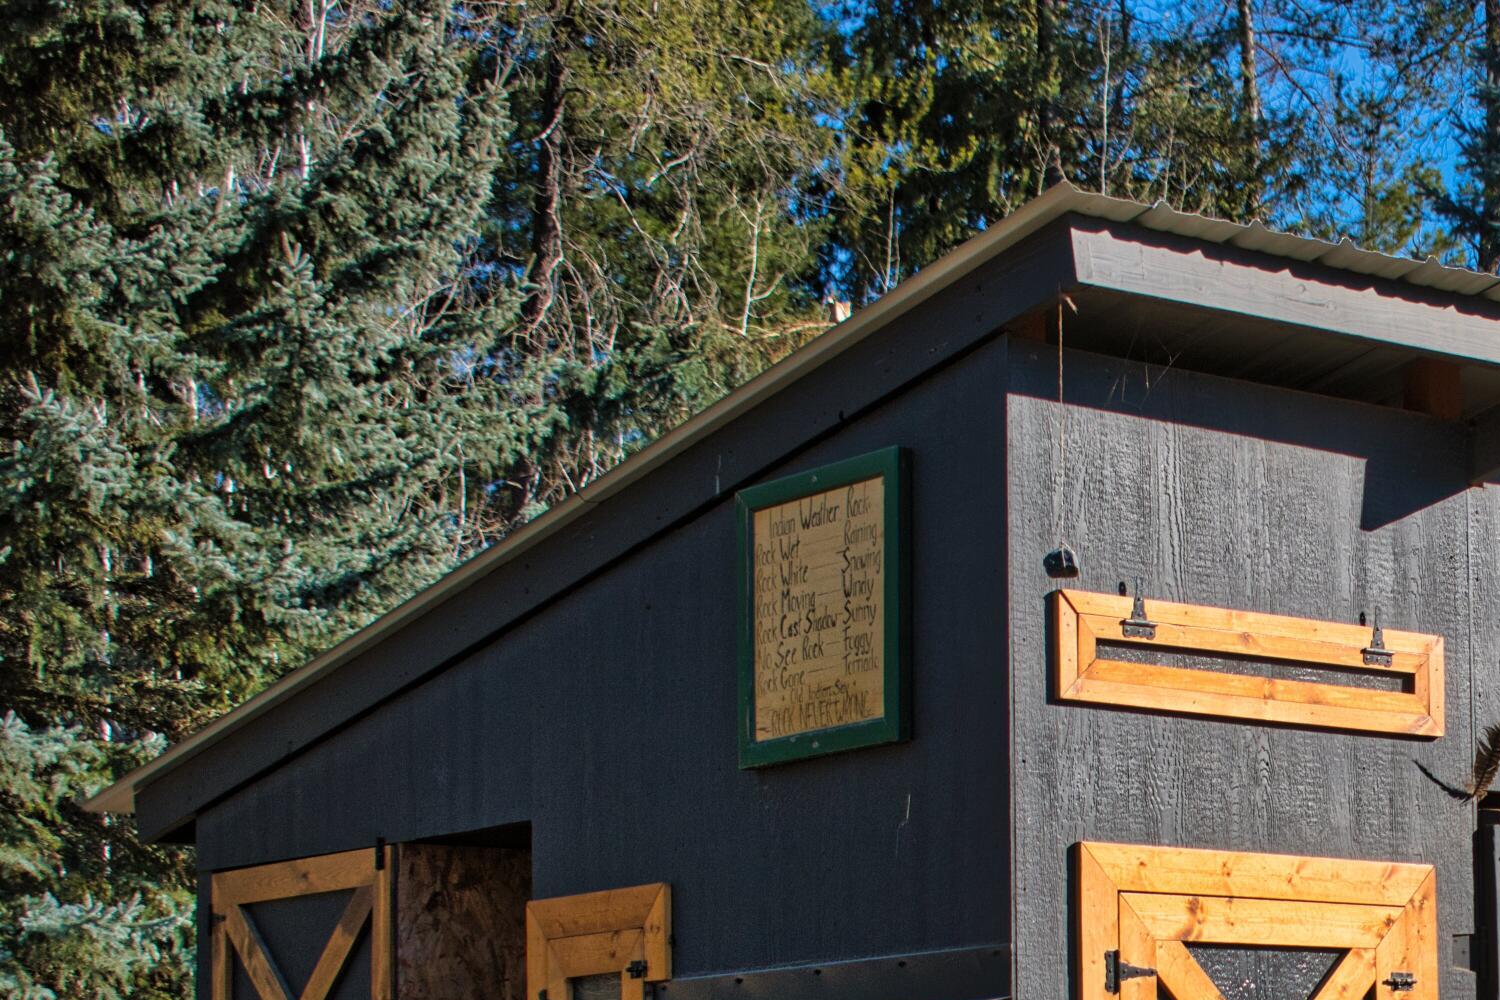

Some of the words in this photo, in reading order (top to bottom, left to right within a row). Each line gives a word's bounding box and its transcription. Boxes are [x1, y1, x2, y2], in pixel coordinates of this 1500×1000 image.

[769, 506, 796, 539] Indian
[800, 495, 840, 531] Weather
[847, 483, 871, 519] Rock
[757, 541, 776, 566] Rock
[780, 535, 800, 561] Wet
[844, 519, 877, 546] Raining
[757, 566, 777, 593] Rock
[780, 561, 808, 587] White
[841, 546, 881, 574] Snowing
[757, 592, 777, 618] Rock
[781, 588, 816, 613] Moving
[843, 573, 875, 601] Windy
[757, 617, 777, 644] Rock
[780, 613, 801, 640] Cast
[842, 600, 877, 626] Sunny
[774, 641, 797, 668] See
[802, 632, 824, 661] Rock
[842, 626, 873, 656] Foggy
[780, 667, 805, 690] Gone
